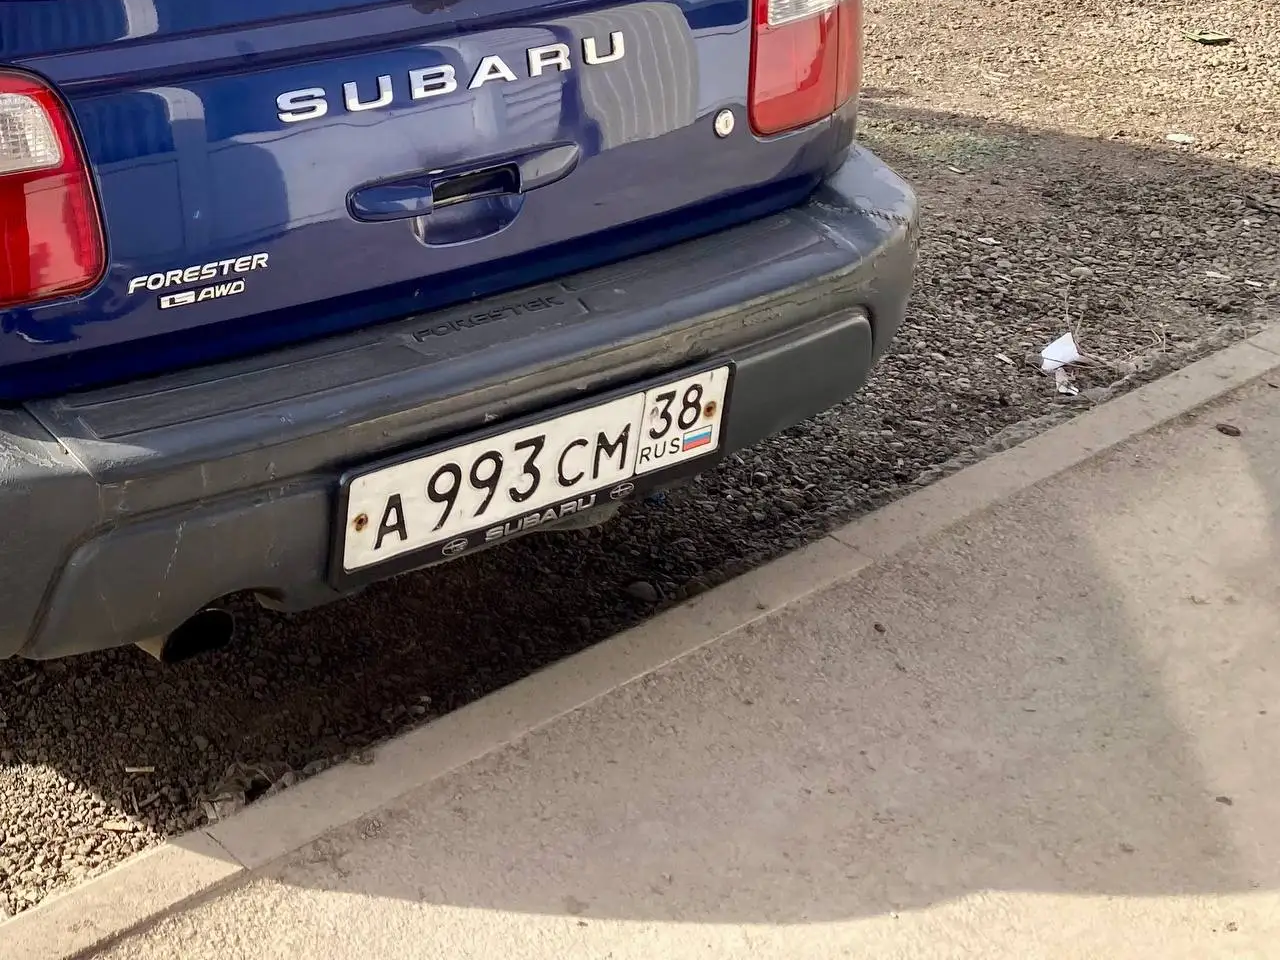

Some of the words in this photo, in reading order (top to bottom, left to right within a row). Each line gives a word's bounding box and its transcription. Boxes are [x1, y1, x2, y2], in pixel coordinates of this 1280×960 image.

[275, 31, 625, 124] SUBARU
[127, 252, 269, 296] FORESTER
[196, 278, 245, 302] AWD
[412, 294, 565, 344] FORESTER
[648, 383, 703, 440] 38
[639, 438, 681, 465] RUS
[484, 494, 597, 542] SUBARU
